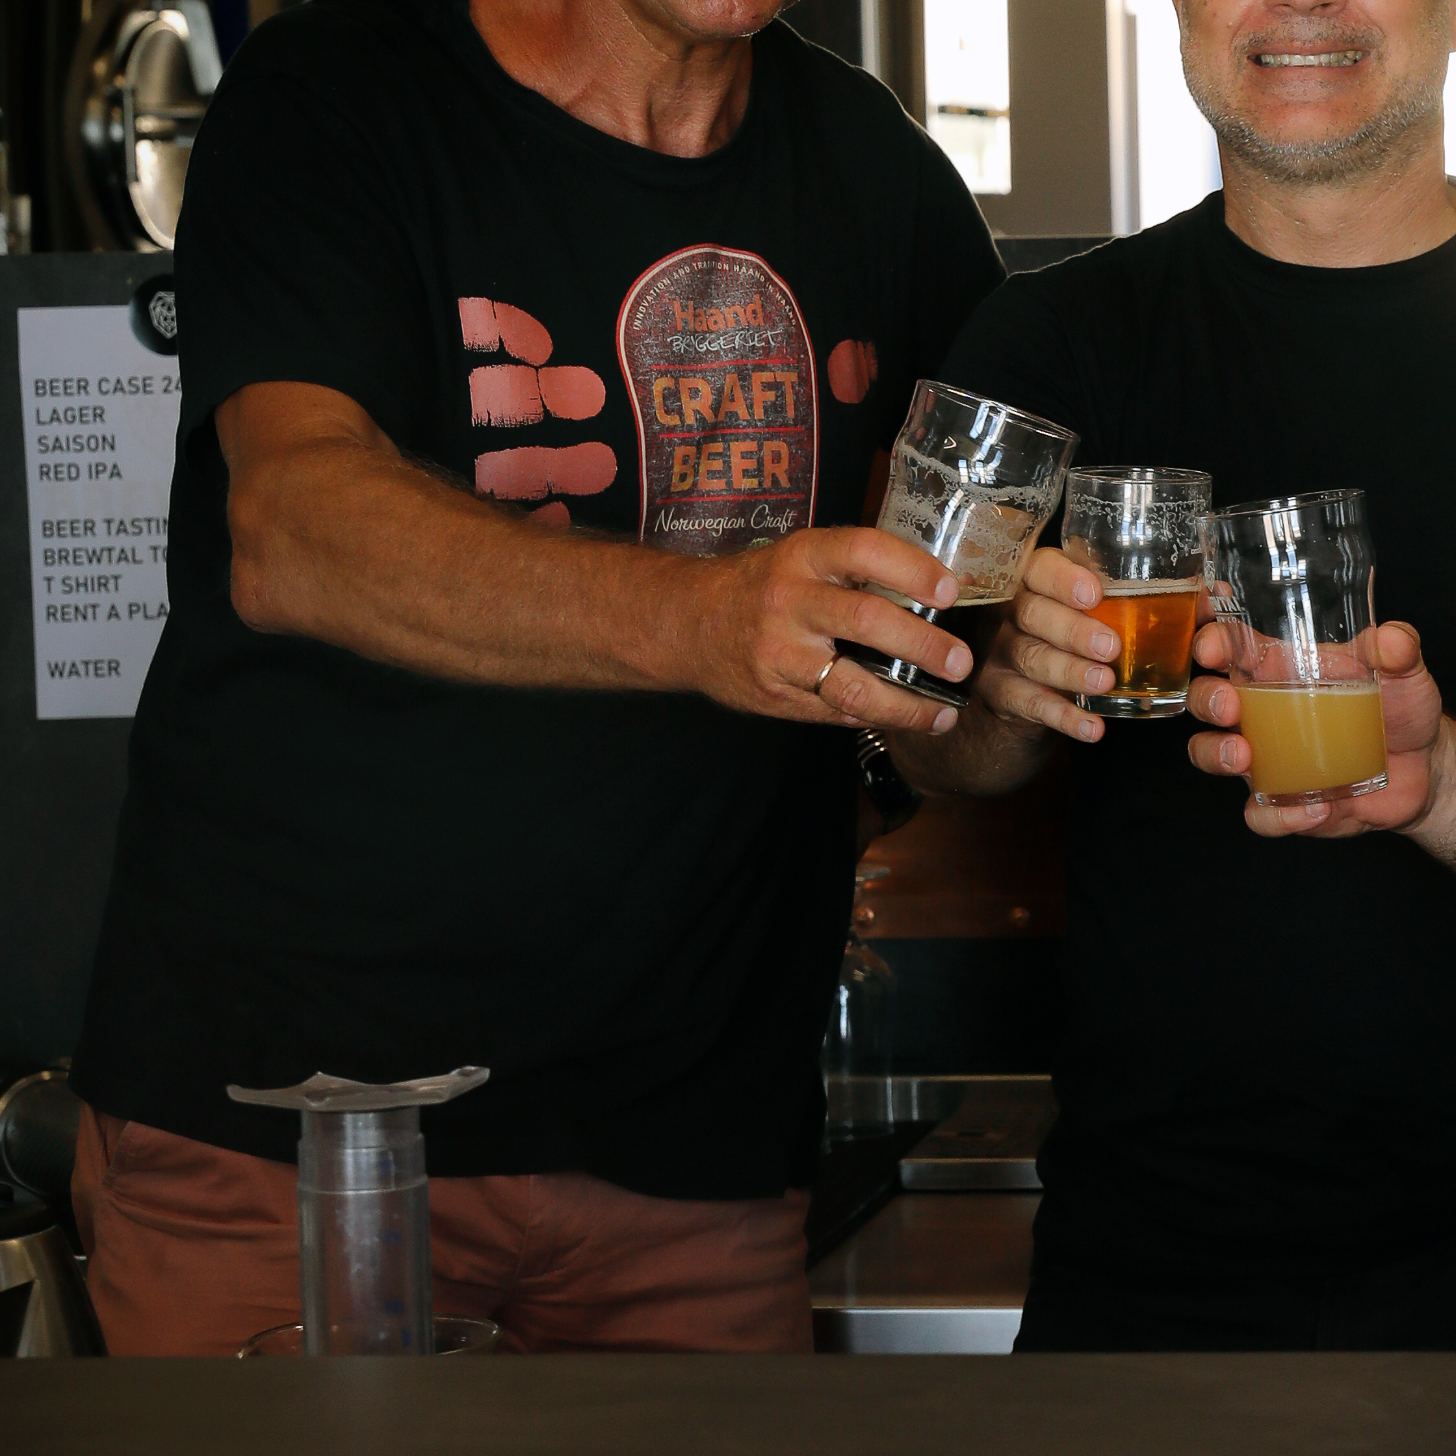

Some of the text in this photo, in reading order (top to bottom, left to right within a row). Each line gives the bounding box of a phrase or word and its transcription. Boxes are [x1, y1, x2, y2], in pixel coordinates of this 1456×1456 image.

[633, 278, 671, 331] INNOVATION
[673, 265, 690, 280] AND
[733, 262, 765, 282] HAAND
[672, 293, 764, 333] Haand
[34, 378, 90, 397] BEER
[98, 376, 154, 395] CASE
[653, 371, 798, 427] CRAFT
[35, 406, 106, 425] LAGER
[37, 433, 117, 454] SAISON
[39, 461, 123, 481] RED IPA
[670, 440, 792, 493] BEER
[42, 518, 97, 538] BEER
[654, 504, 798, 537] Norwegian Craft
[44, 546, 144, 566] BREWTAL
[44, 574, 123, 594] T SHIRT
[46, 603, 99, 623] RENT
[107, 603, 121, 621] A
[47, 659, 121, 678] WATER
